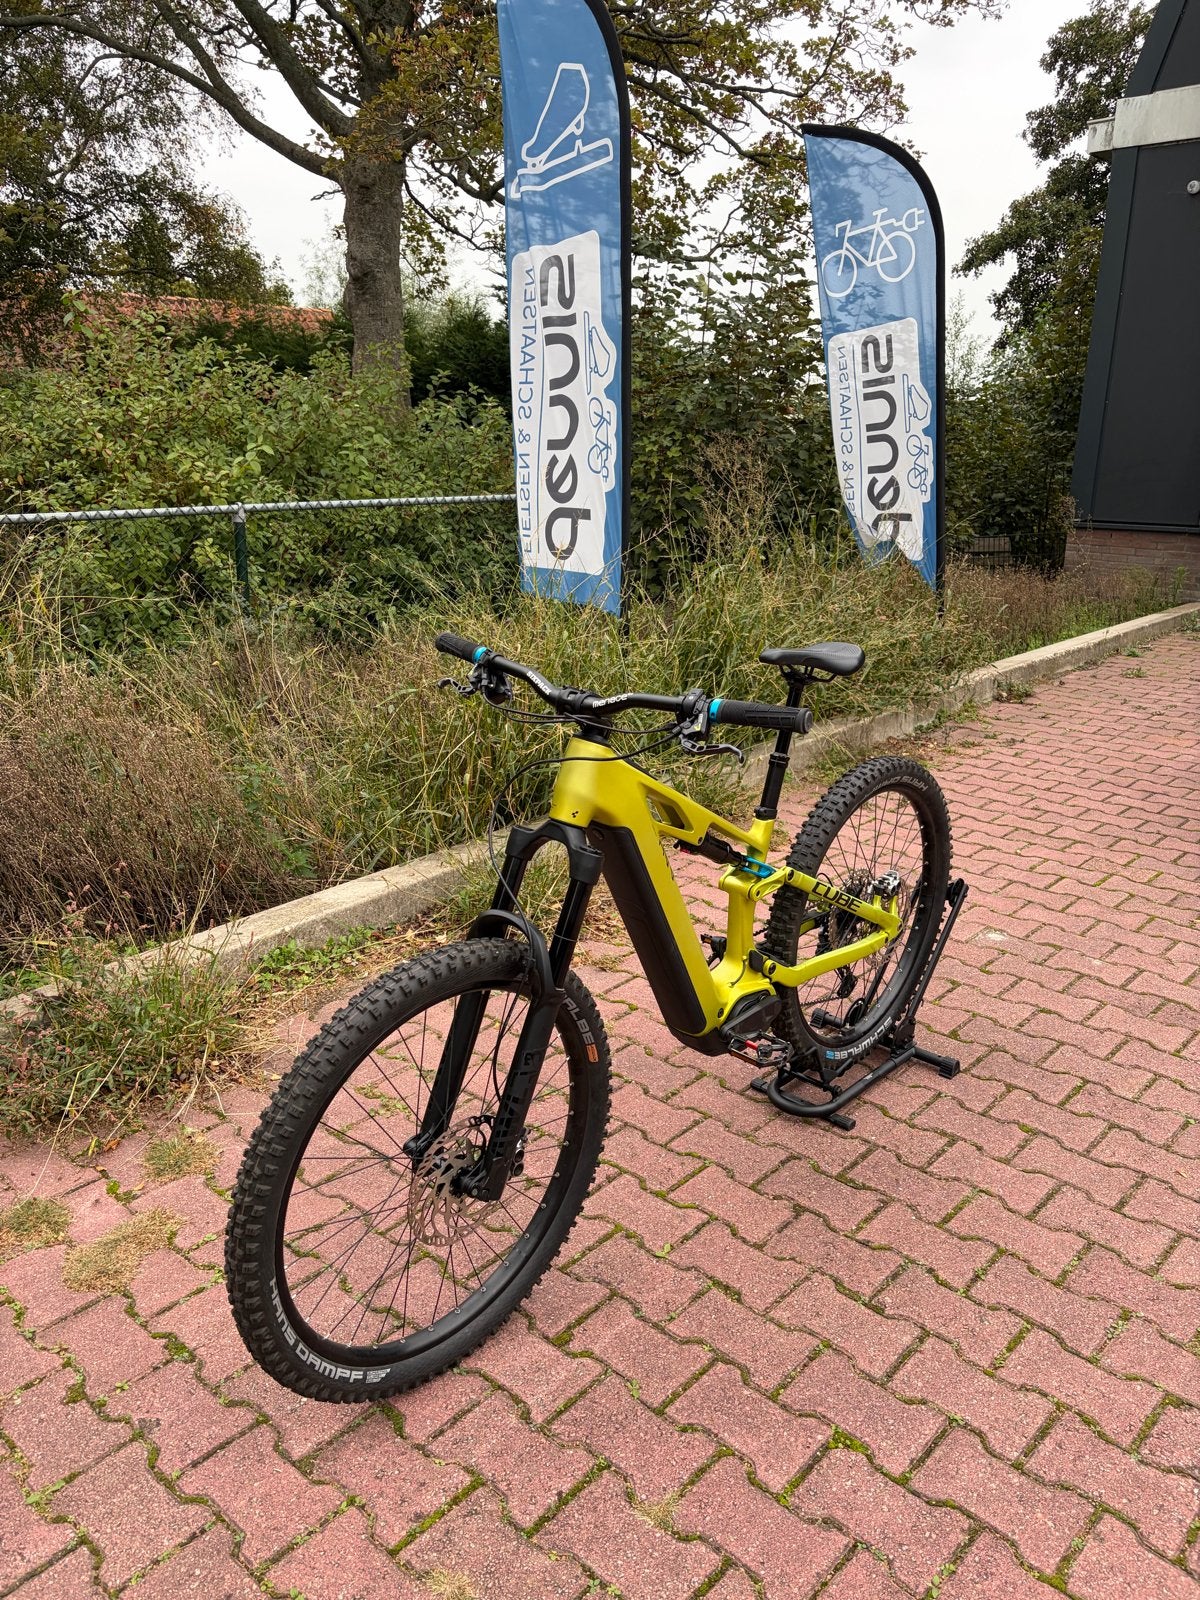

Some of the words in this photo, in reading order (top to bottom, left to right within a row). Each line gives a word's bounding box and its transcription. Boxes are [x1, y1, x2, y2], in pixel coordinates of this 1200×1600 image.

[526, 670, 552, 696] SIXPACK
[593, 693, 629, 708] menace
[811, 880, 865, 913] CUBE
[561, 995, 595, 1045] ALBE
[834, 1016, 892, 1060] SCHWALBE
[269, 1276, 296, 1347] HANS
[295, 1346, 364, 1383] DAMPF
